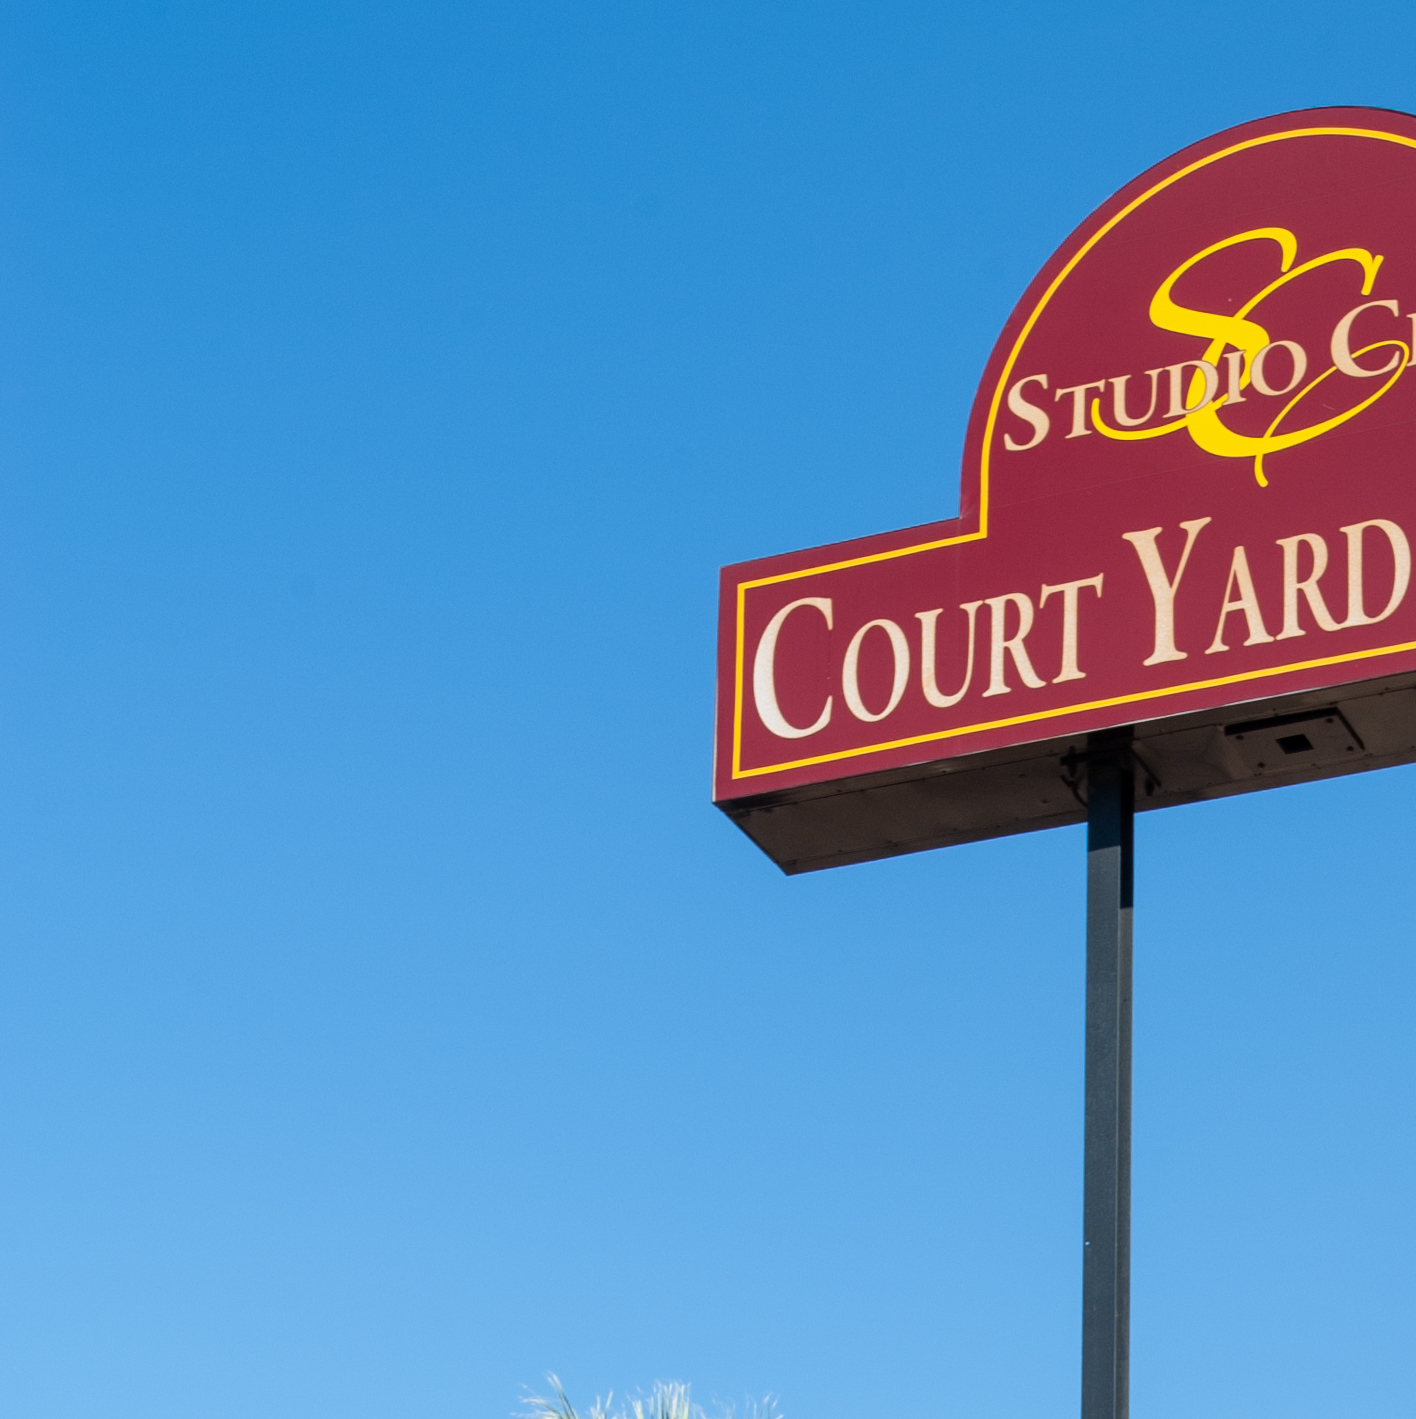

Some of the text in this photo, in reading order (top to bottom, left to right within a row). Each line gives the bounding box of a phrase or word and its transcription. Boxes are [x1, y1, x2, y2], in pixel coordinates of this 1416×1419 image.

[1003, 339, 1308, 452] STUDIO
[752, 573, 1105, 740] COURT
[1121, 516, 1412, 667] YARD
